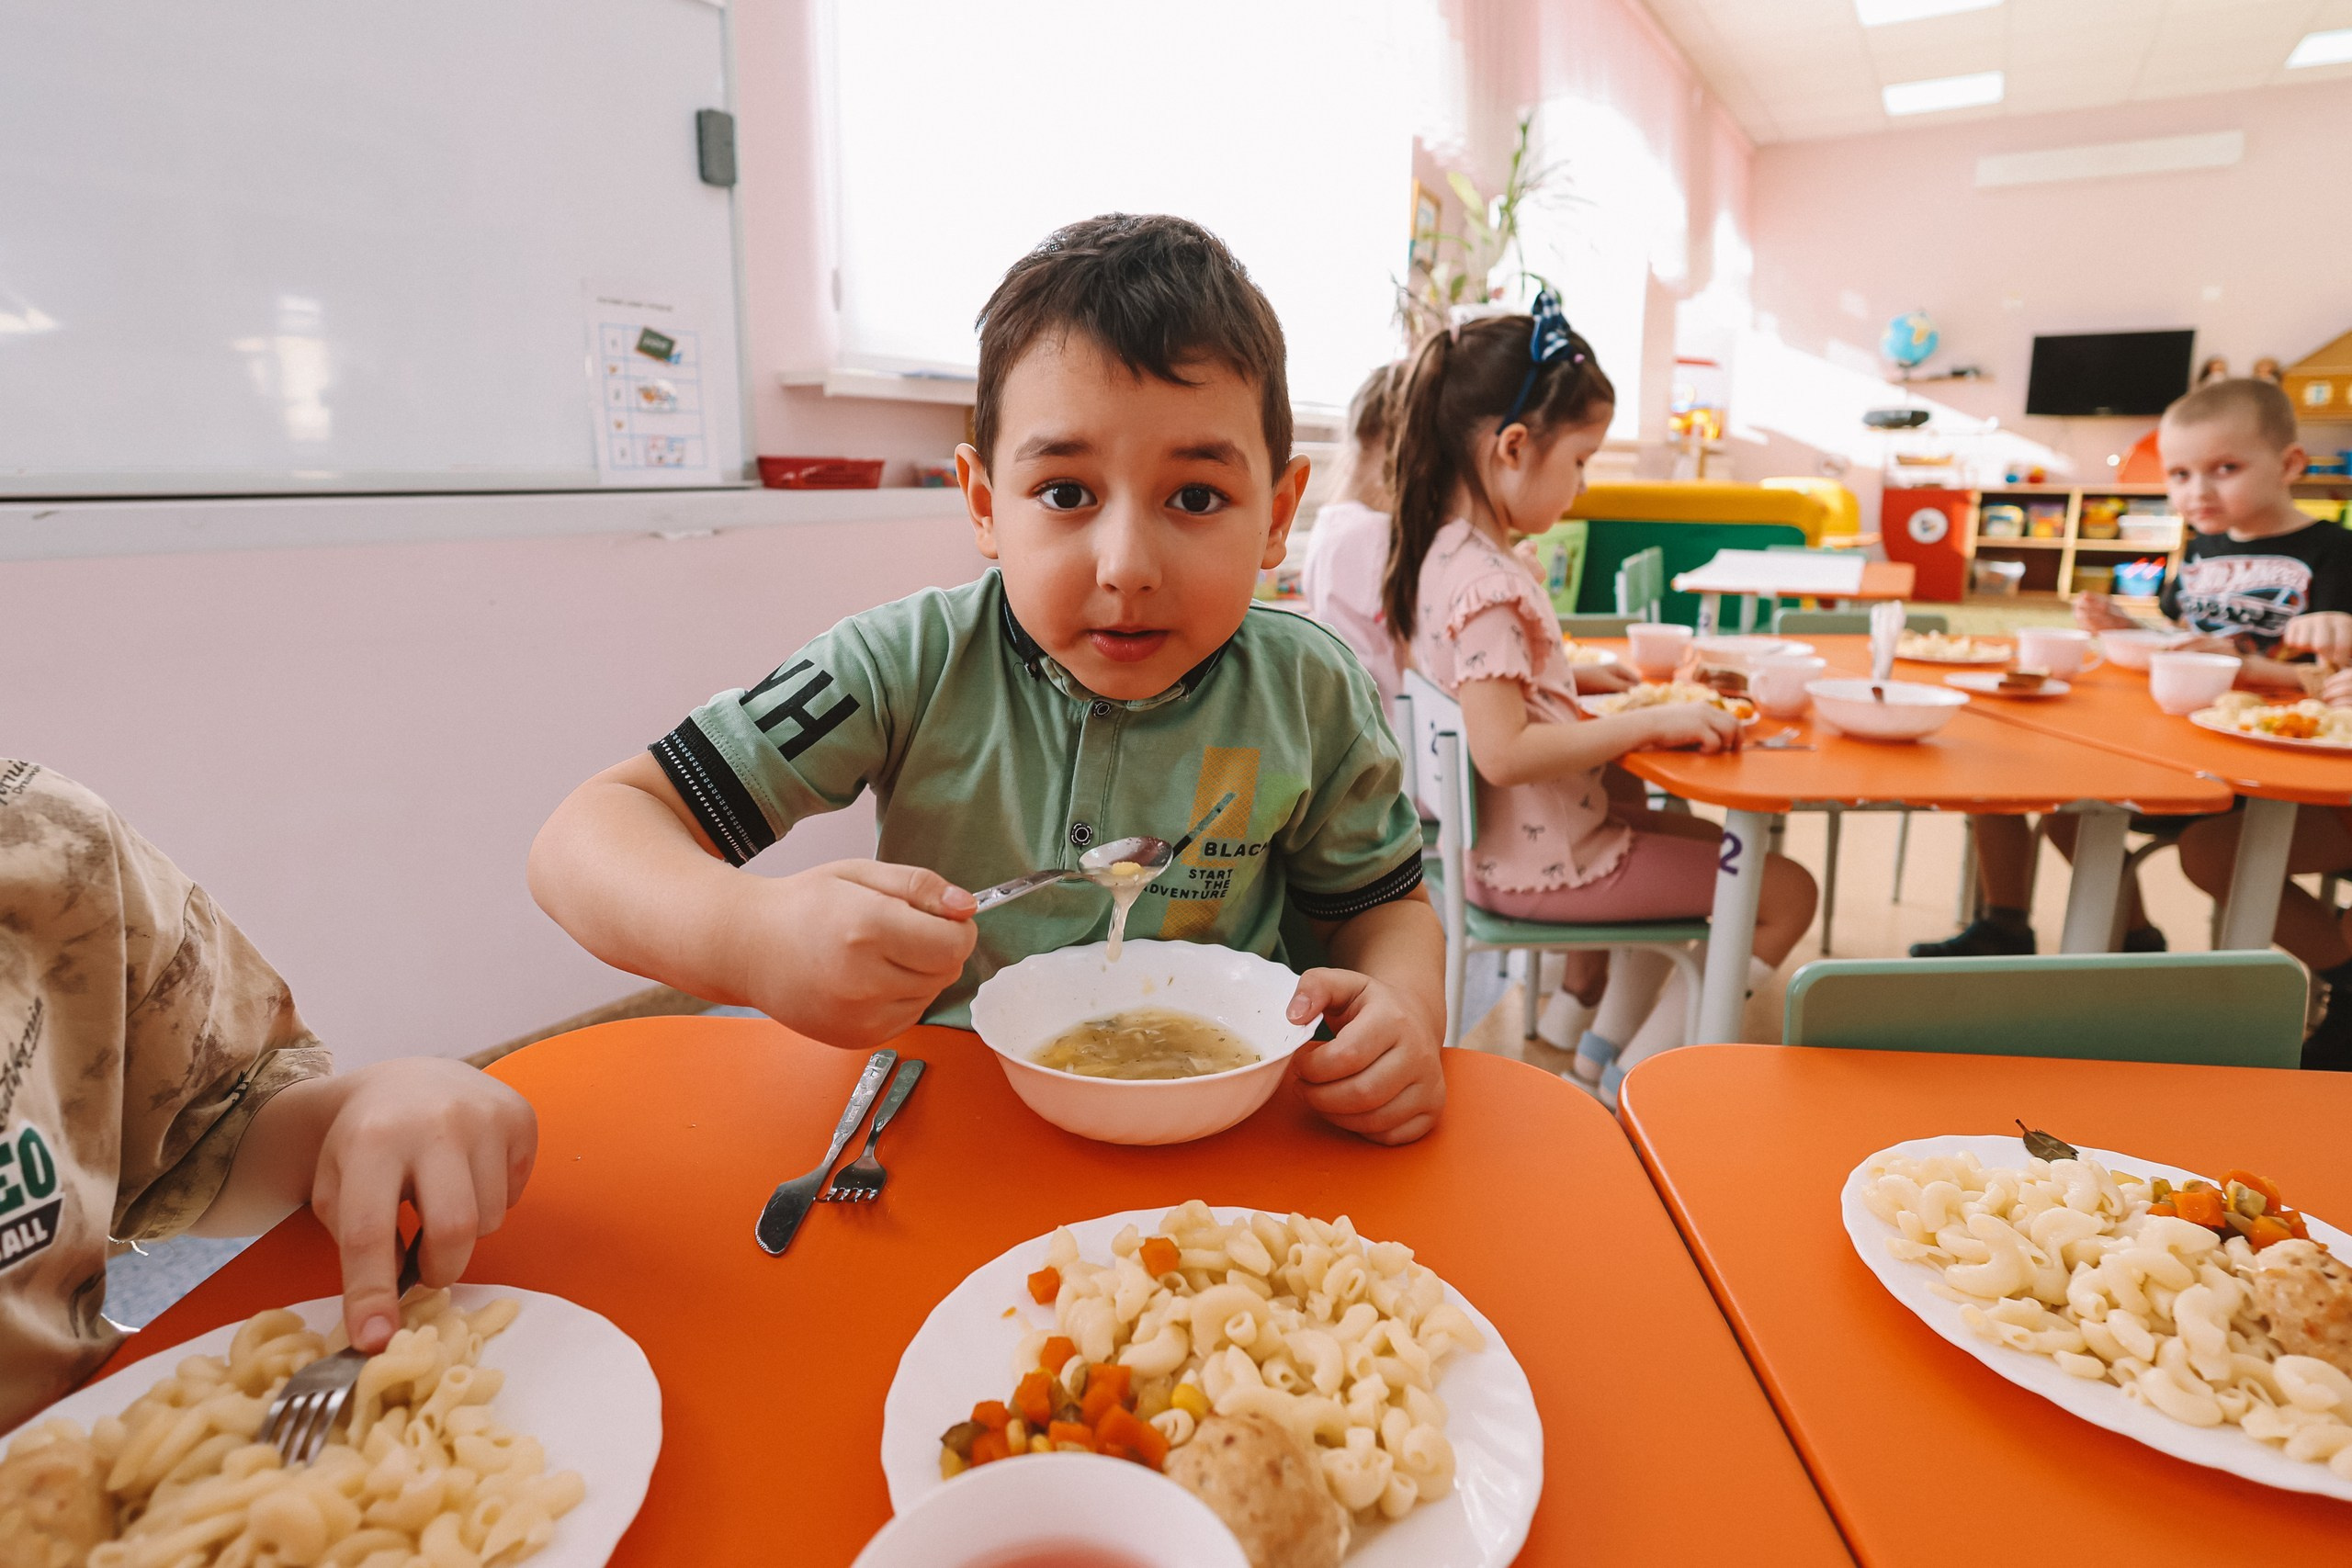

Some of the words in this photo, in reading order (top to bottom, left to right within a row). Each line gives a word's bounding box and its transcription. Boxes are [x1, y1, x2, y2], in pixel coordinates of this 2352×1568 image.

[1719, 831, 1743, 876] 2
[1188, 868, 1234, 880] START
[1204, 879, 1231, 890] THE
[0, 1217, 49, 1260] ALL
